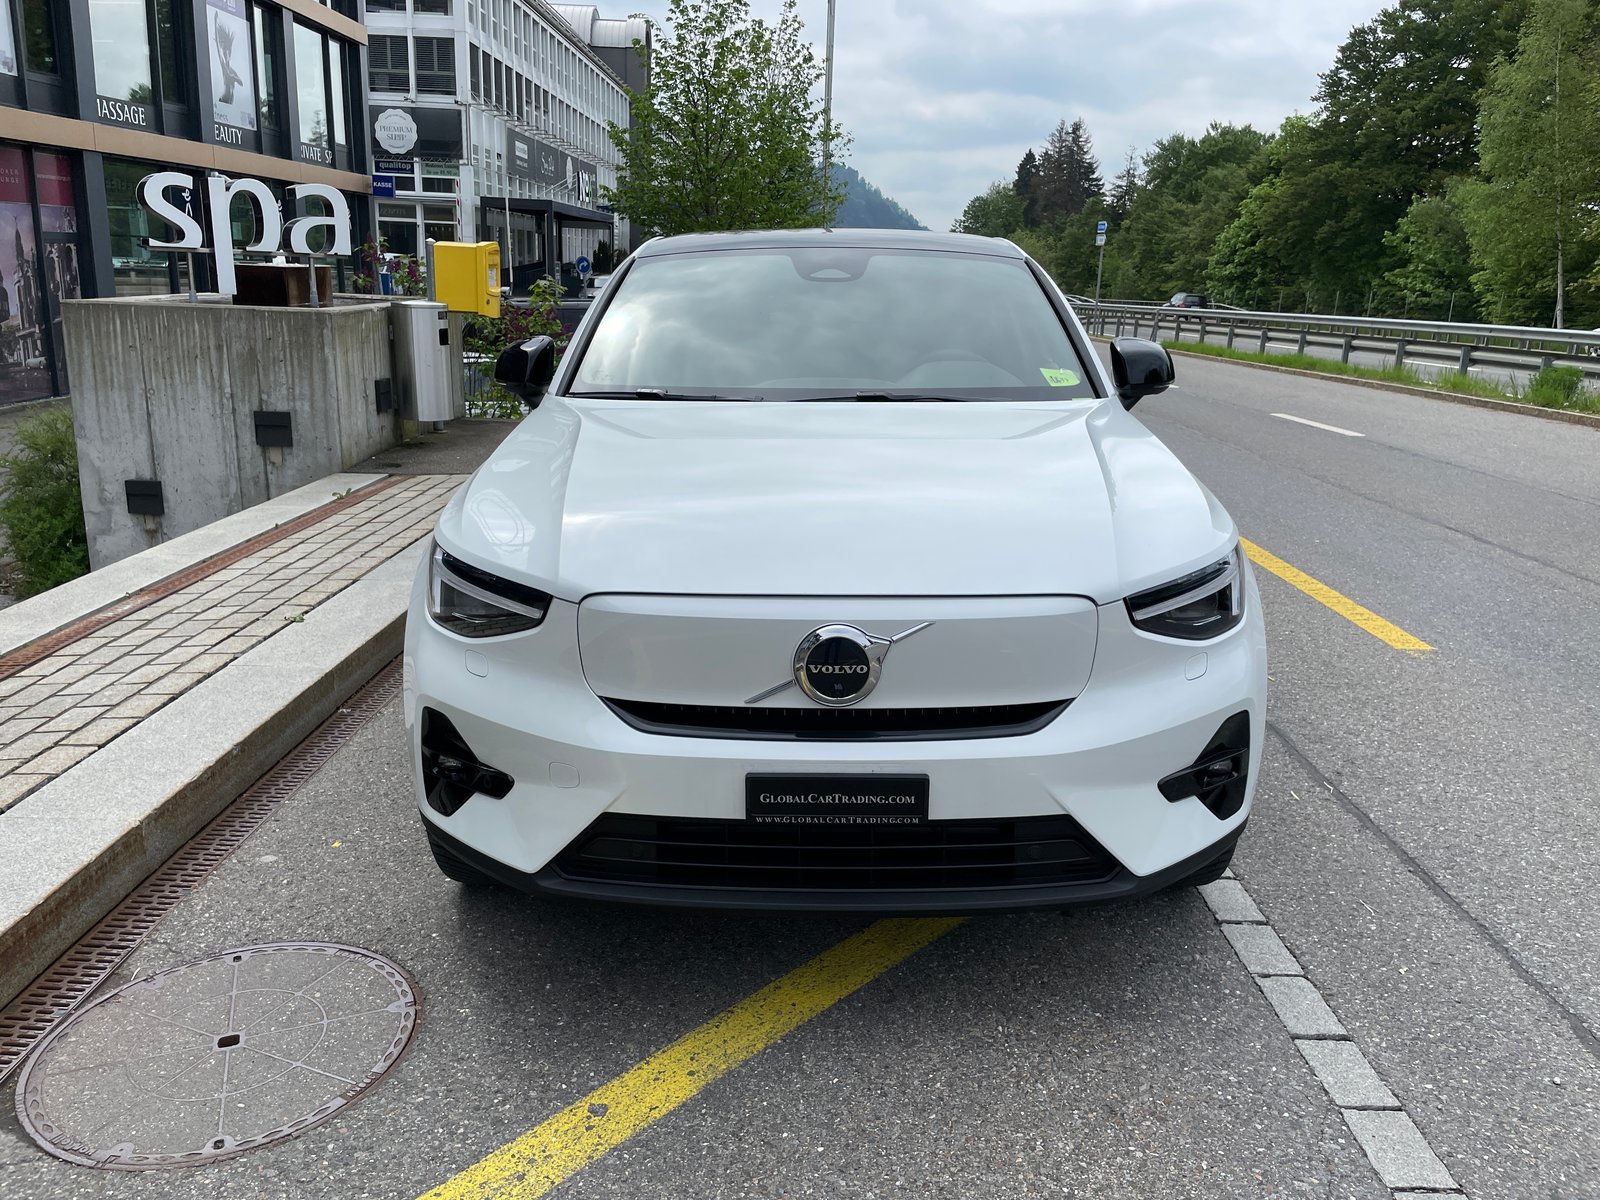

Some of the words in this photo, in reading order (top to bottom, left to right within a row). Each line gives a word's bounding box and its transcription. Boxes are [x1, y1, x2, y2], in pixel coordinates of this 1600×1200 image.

[379, 125, 413, 133] PREMIUM
[379, 161, 412, 170] qualitop
[373, 181, 393, 189] KASSE
[136, 171, 352, 295] spa
[807, 664, 869, 674] VOLVO
